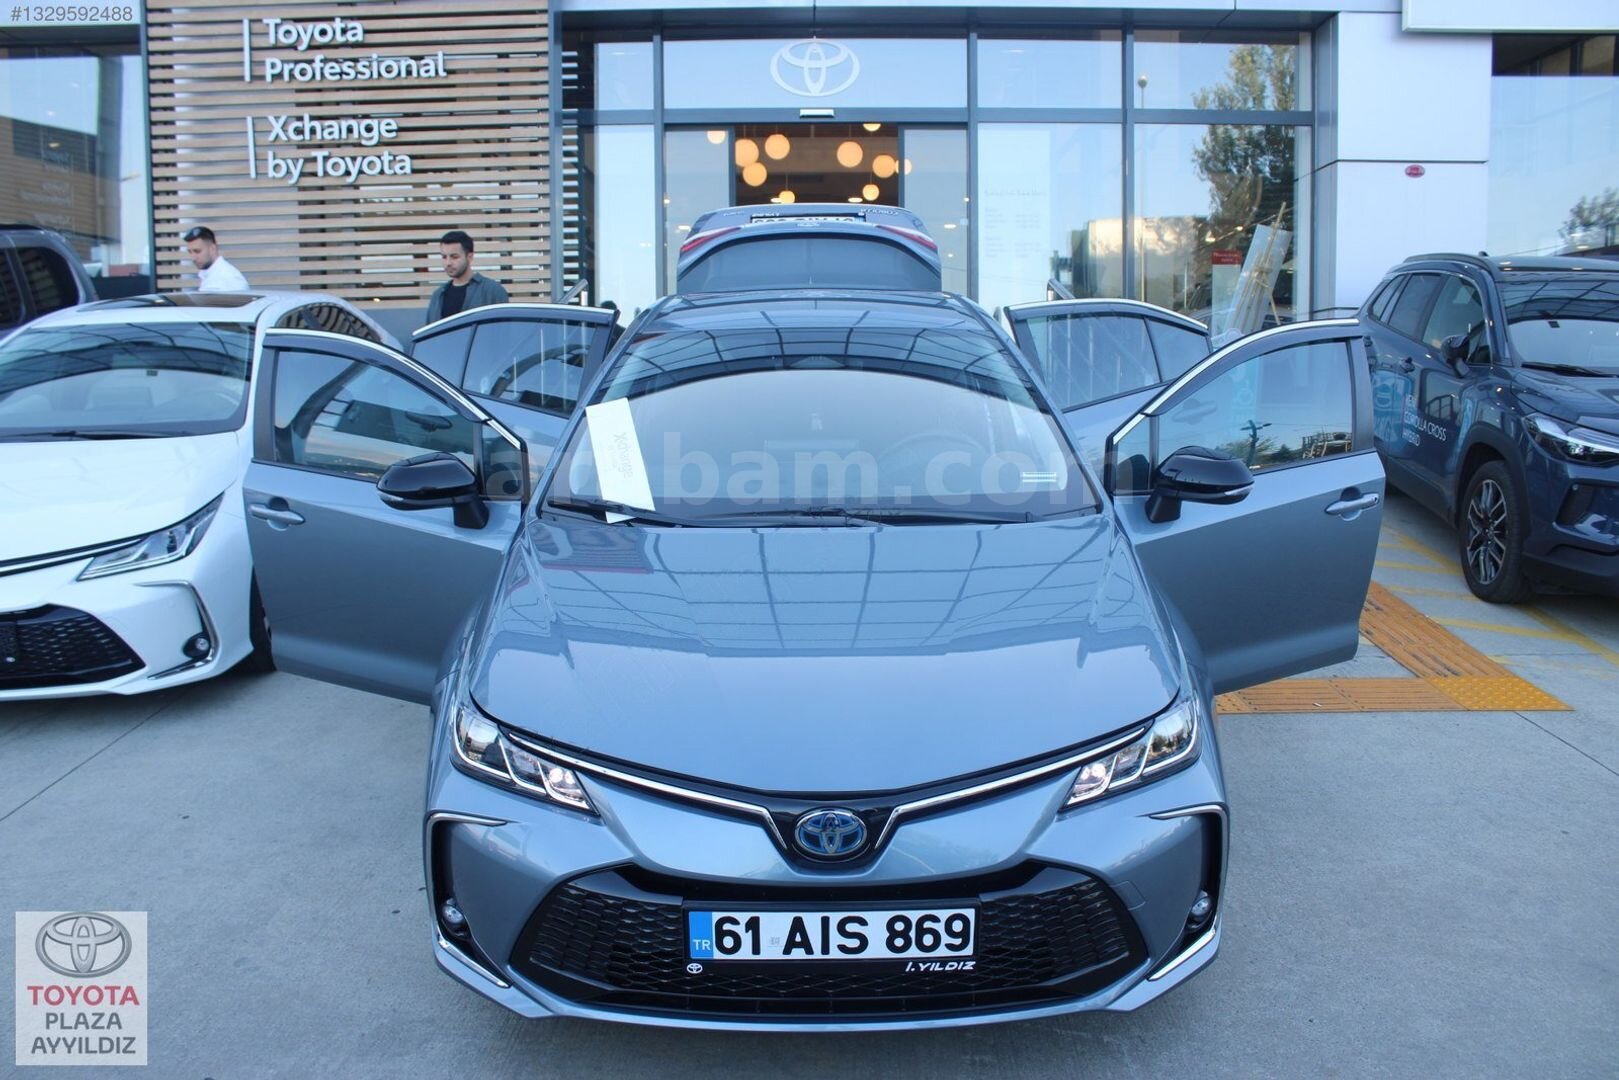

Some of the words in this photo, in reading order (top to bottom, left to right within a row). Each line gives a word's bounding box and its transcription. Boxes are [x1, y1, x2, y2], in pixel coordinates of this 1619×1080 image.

[263, 17, 364, 51] Toyota
[264, 51, 447, 83] Professional
[267, 113, 398, 146] Xchange
[267, 151, 304, 184] by
[312, 151, 412, 183] Toyota
[1427, 422, 1447, 441] CROSS
[693, 940, 711, 951] TR
[714, 916, 761, 955] 61
[782, 916, 869, 955] AIS
[886, 913, 971, 953] 869
